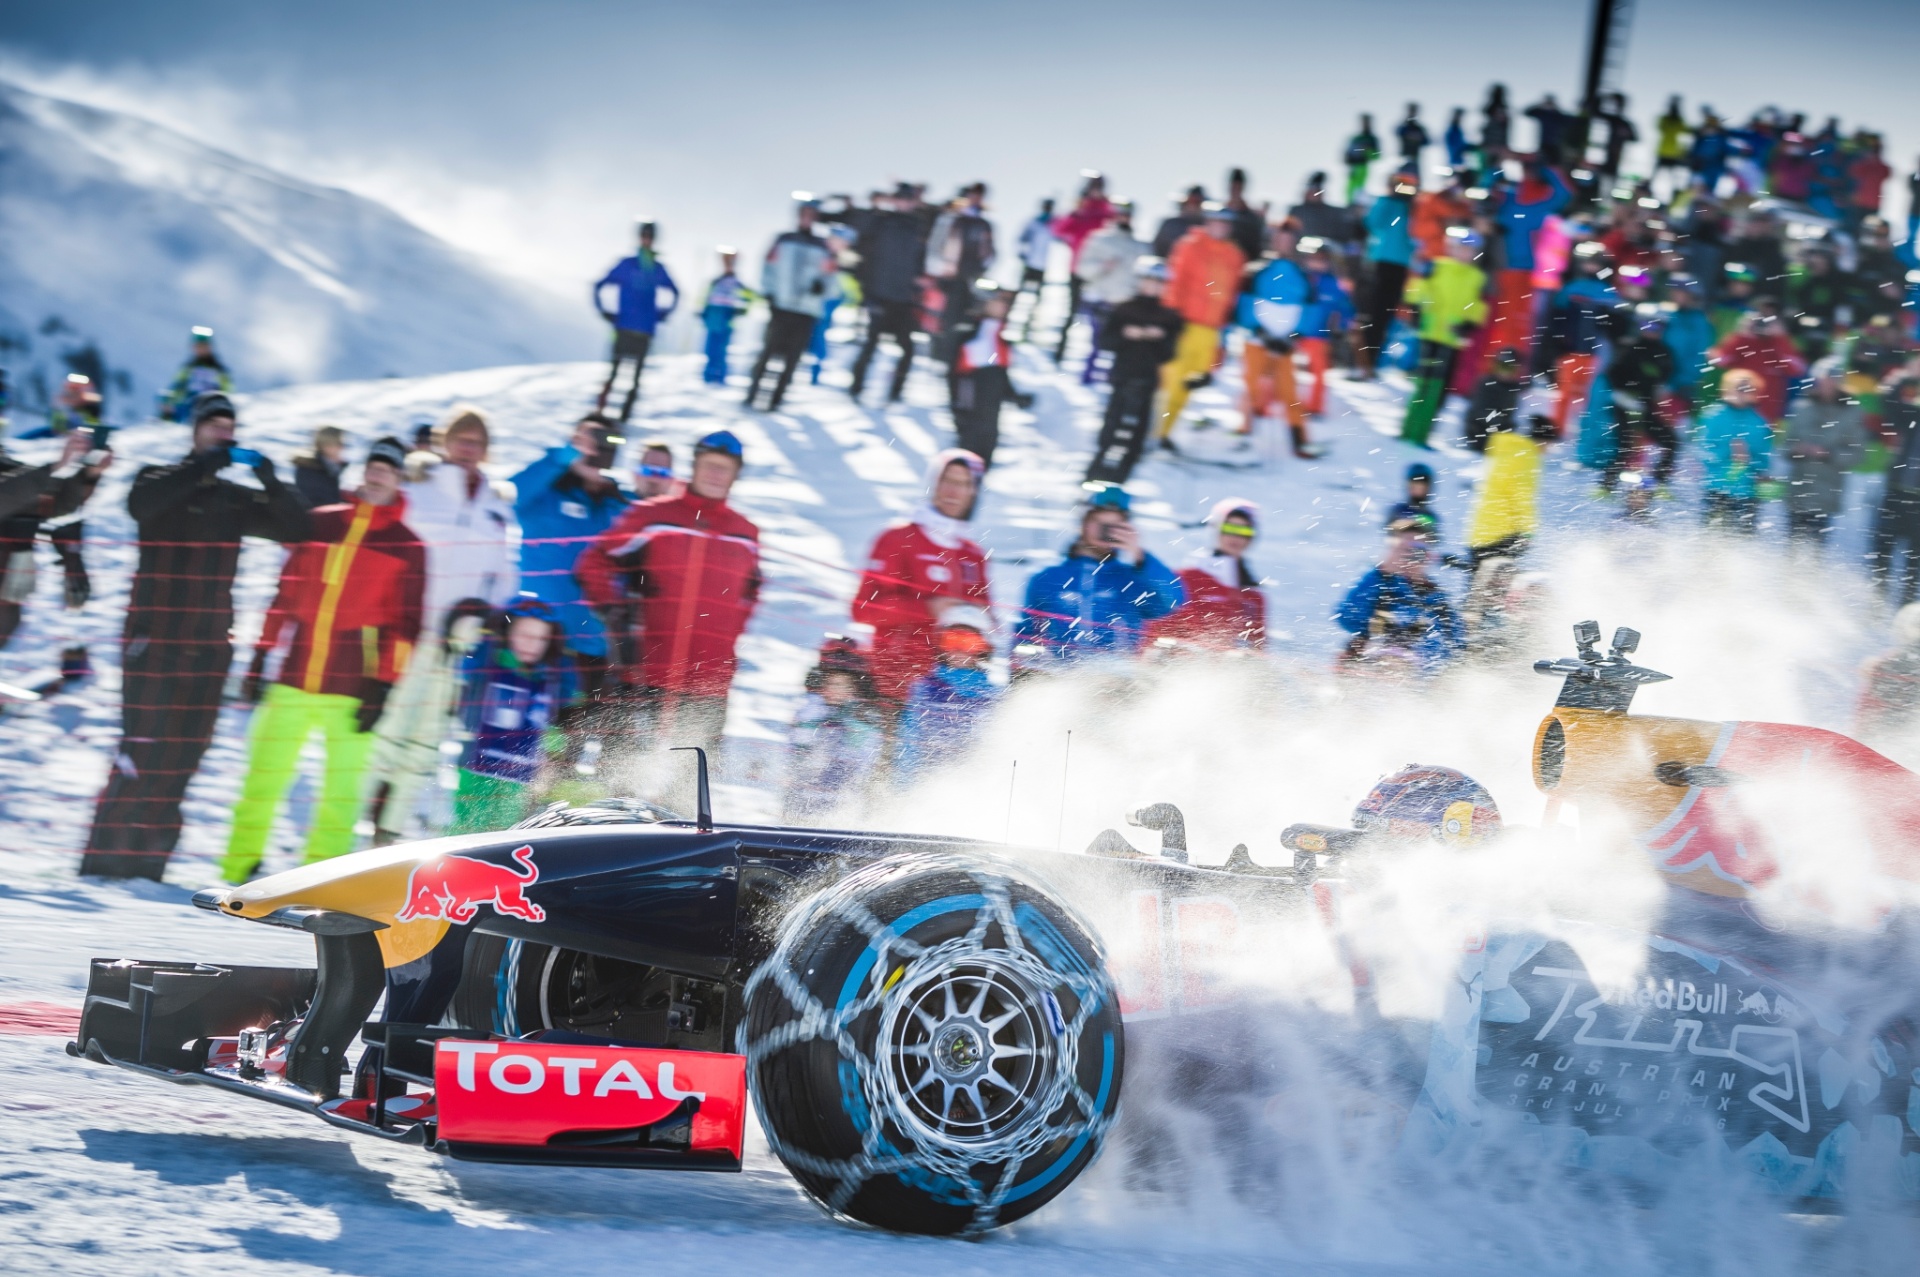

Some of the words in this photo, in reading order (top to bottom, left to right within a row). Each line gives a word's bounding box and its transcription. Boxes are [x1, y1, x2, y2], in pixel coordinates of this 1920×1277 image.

[439, 1041, 706, 1101] TOTAL
[1521, 1053, 1736, 1090] AUSTRIAN
[1513, 1073, 1632, 1100] GRAND
[1657, 1090, 1731, 1111] PRIX
[1506, 1094, 1554, 1109] 3rd
[1664, 1111, 1727, 1130] 206
